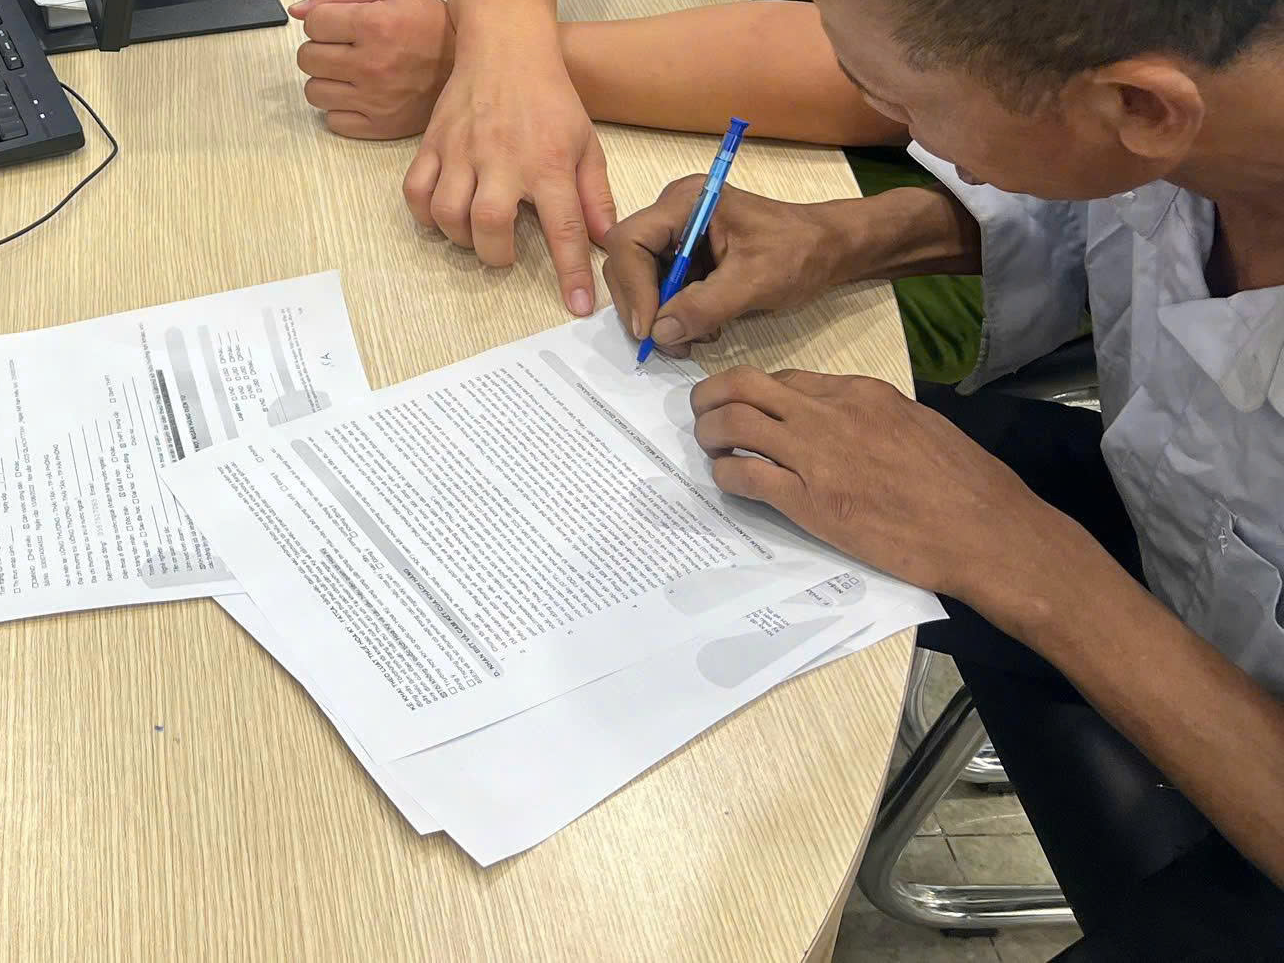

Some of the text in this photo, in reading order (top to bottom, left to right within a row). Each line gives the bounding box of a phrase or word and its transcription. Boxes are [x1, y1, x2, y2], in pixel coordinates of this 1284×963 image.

[589, 395, 604, 408] NGÂN
[602, 408, 615, 419] DỊCH
[614, 418, 627, 429] GIAO
[632, 435, 645, 445] CHỮ
[643, 445, 655, 455] MẪU
[661, 460, 674, 473] THỜI
[673, 472, 692, 487] (ĐỒNG
[689, 487, 705, 500] HÀNG
[704, 500, 723, 516] KHÁCH
[722, 516, 735, 527] CHO
[734, 526, 751, 540] DÀNH
[749, 540, 766, 553] PHẦN
[325, 554, 334, 564] Hoa
[338, 569, 350, 581] quan
[403, 568, 417, 582] HÀNG
[348, 581, 356, 589] liên
[415, 582, 433, 600] KHÁCH
[355, 589, 365, 599] hiệu
[363, 599, 373, 608] dấu
[432, 599, 443, 612] CỦA
[329, 605, 345, 622] FATCA
[371, 608, 380, 616] các
[440, 611, 452, 621] KẾT
[382, 623, 391, 631] Kỳ
[450, 621, 462, 633] CAM
[352, 633, 363, 645] HOA
[389, 629, 400, 641] Hoa
[460, 633, 469, 642] VÀ
[398, 640, 407, 650] tịch
[467, 642, 480, 653] BIẾT
[359, 645, 373, 659] THUẾ
[405, 649, 417, 661] quốc
[371, 659, 386, 672] LUẬT
[479, 653, 494, 669] NHẬN
[383, 672, 396, 687] THEO
[421, 668, 436, 684] không
[433, 683, 442, 693] Tôi
[396, 688, 408, 701] KHAI
[405, 701, 415, 710] KÊ
